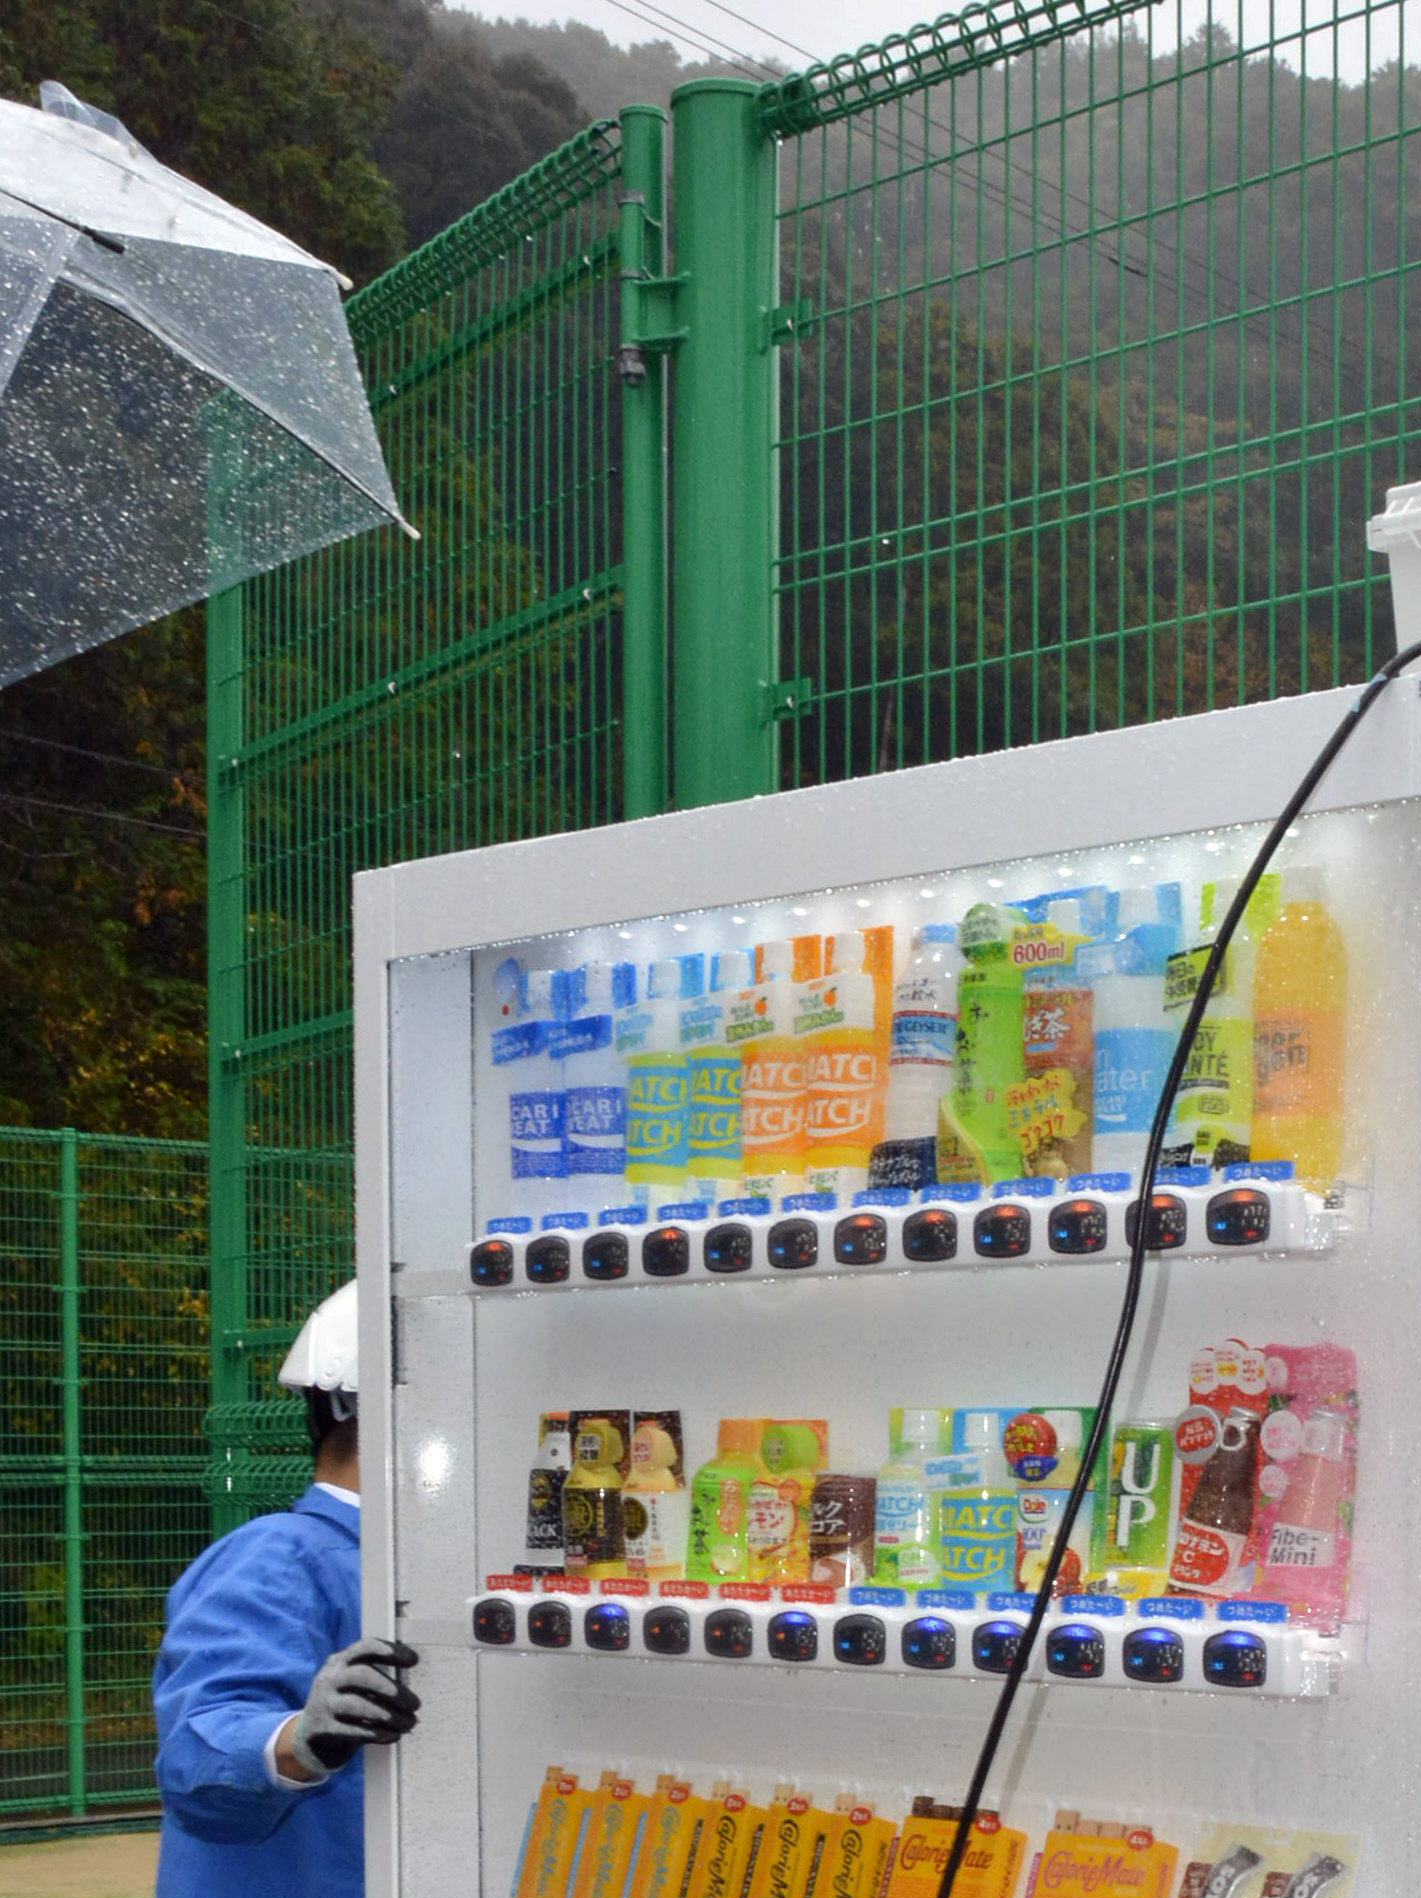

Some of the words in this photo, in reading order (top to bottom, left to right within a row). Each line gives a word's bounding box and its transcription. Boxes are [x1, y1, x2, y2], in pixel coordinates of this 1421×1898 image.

[1013, 941, 1065, 964] 600ml
[900, 1834, 994, 1874] Calorieate
[1043, 1850, 1147, 1892] CalorieMate
